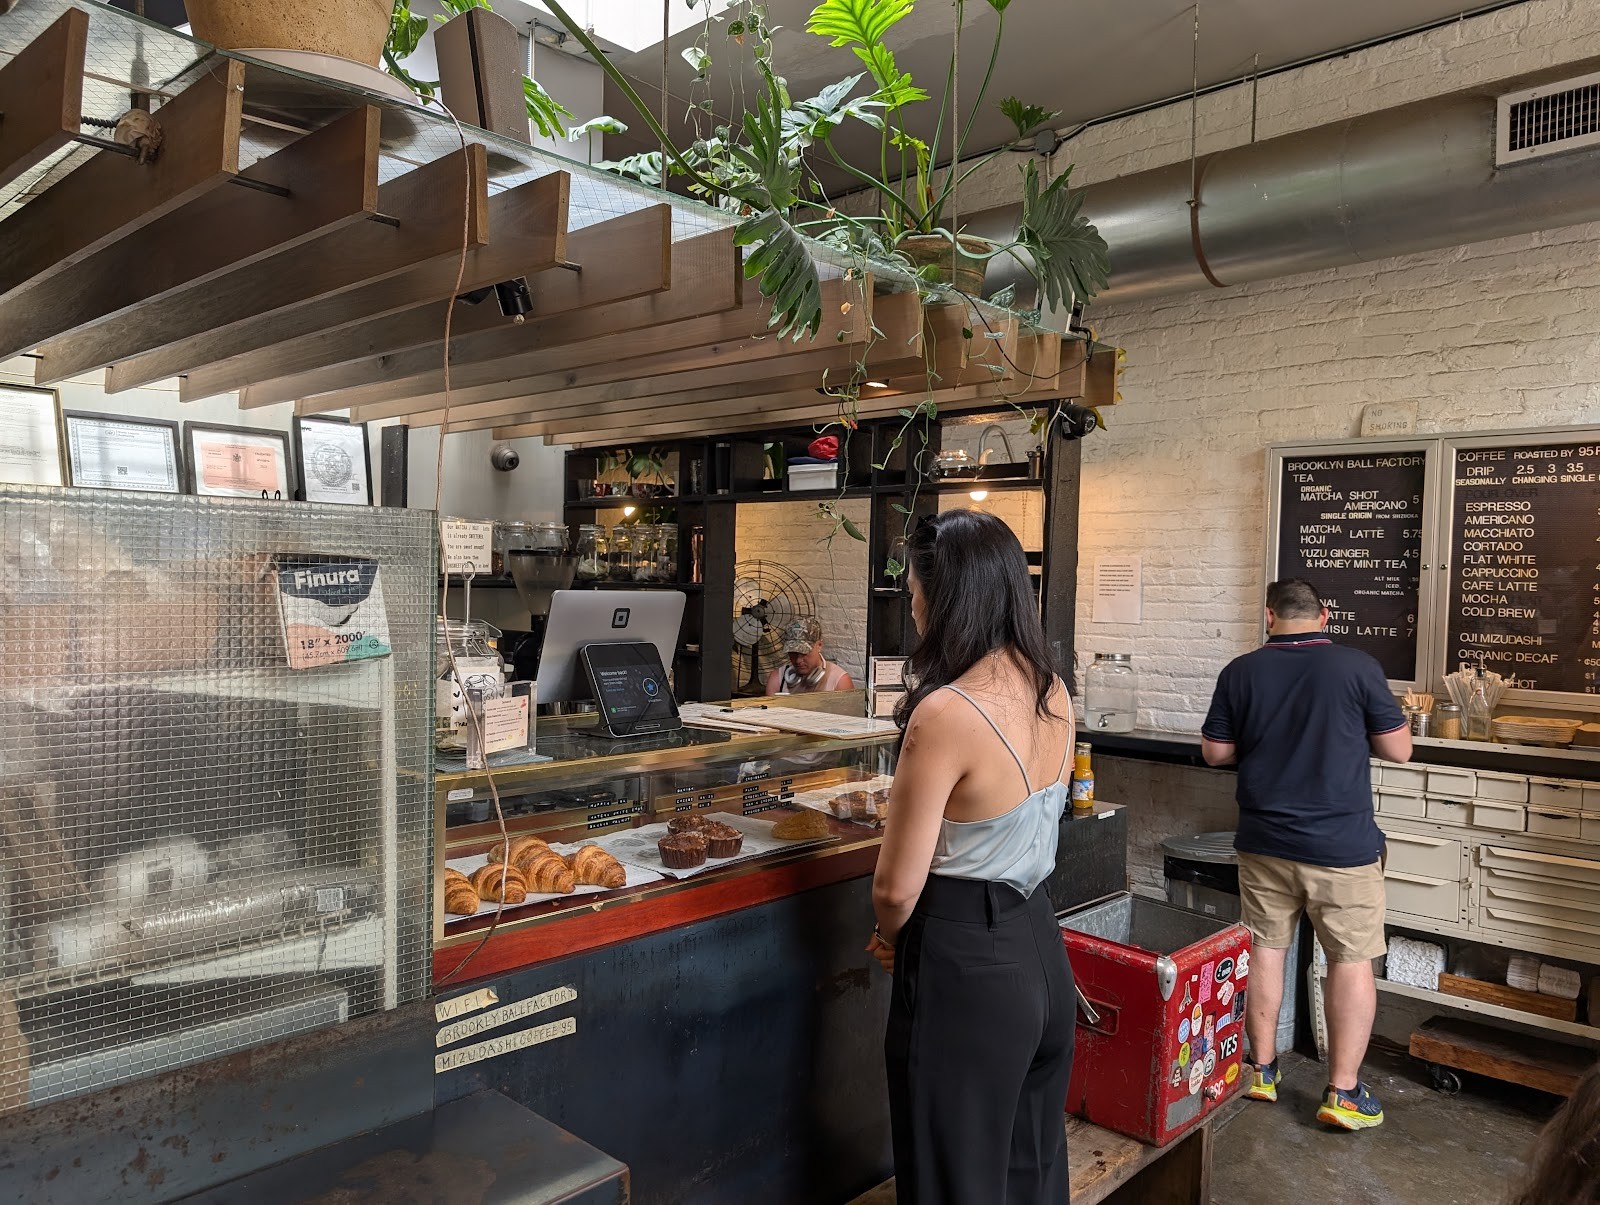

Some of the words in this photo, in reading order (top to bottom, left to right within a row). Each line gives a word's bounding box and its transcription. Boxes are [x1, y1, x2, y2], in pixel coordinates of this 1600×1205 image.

[1369, 421, 1408, 431] SMOKING
[1457, 450, 1506, 462] COFFEE
[1513, 449, 1558, 460] ROASTED
[1560, 449, 1574, 458] BY
[1287, 460, 1344, 472] BROOKLYN
[1347, 459, 1374, 469] BALL
[1376, 457, 1425, 468] FACTORY
[1466, 466, 1495, 477] DRIP
[1516, 464, 1535, 475] 2.5
[1547, 463, 1556, 474] 3
[1293, 473, 1314, 483] TEA
[1455, 477, 1506, 486] SEASONALLY
[1512, 475, 1558, 485] CHANGING
[1560, 473, 1596, 483] SINGLE
[1300, 485, 1332, 493] ORGANIC
[1300, 492, 1343, 502] MATCHA
[1349, 490, 1379, 500] SHOT
[1343, 500, 1408, 511] AMERICANO
[1465, 500, 1531, 512] ESPRESSO
[1320, 512, 1347, 520] SINGLE
[1464, 514, 1535, 525] AMERICANO
[1300, 525, 1342, 534] MATCHA
[1350, 529, 1385, 539] LATTE
[1464, 528, 1535, 538] MACCHIATO
[1300, 535, 1326, 544] HOJI
[1463, 541, 1523, 552] CORTADO
[1300, 549, 1327, 559] YUZU
[1329, 549, 1370, 558] GINGER
[1463, 554, 1493, 564] FLAT
[1497, 555, 1536, 565] WHITE
[1353, 559, 1380, 569] MINT
[1384, 560, 1408, 569] TEA
[1462, 568, 1539, 578] CAPPUCCINO
[294, 568, 360, 590] Finura
[1462, 581, 1494, 591] CAFE
[1498, 581, 1538, 592] LATTE
[1461, 593, 1508, 604] MOCHA
[1327, 611, 1356, 621] ATTE
[1461, 606, 1495, 617] COLD
[1498, 608, 1536, 619] BREW
[1407, 614, 1415, 623] 6
[1356, 626, 1398, 637] LATTE
[1406, 628, 1414, 638] 7
[1460, 632, 1478, 642] OJI
[1480, 633, 1542, 646] MIZUDASHI
[1458, 648, 1513, 661] ORGANIC
[1515, 652, 1558, 664] DECAF
[1511, 679, 1538, 689] HOT
[1220, 1033, 1238, 1060] YES
